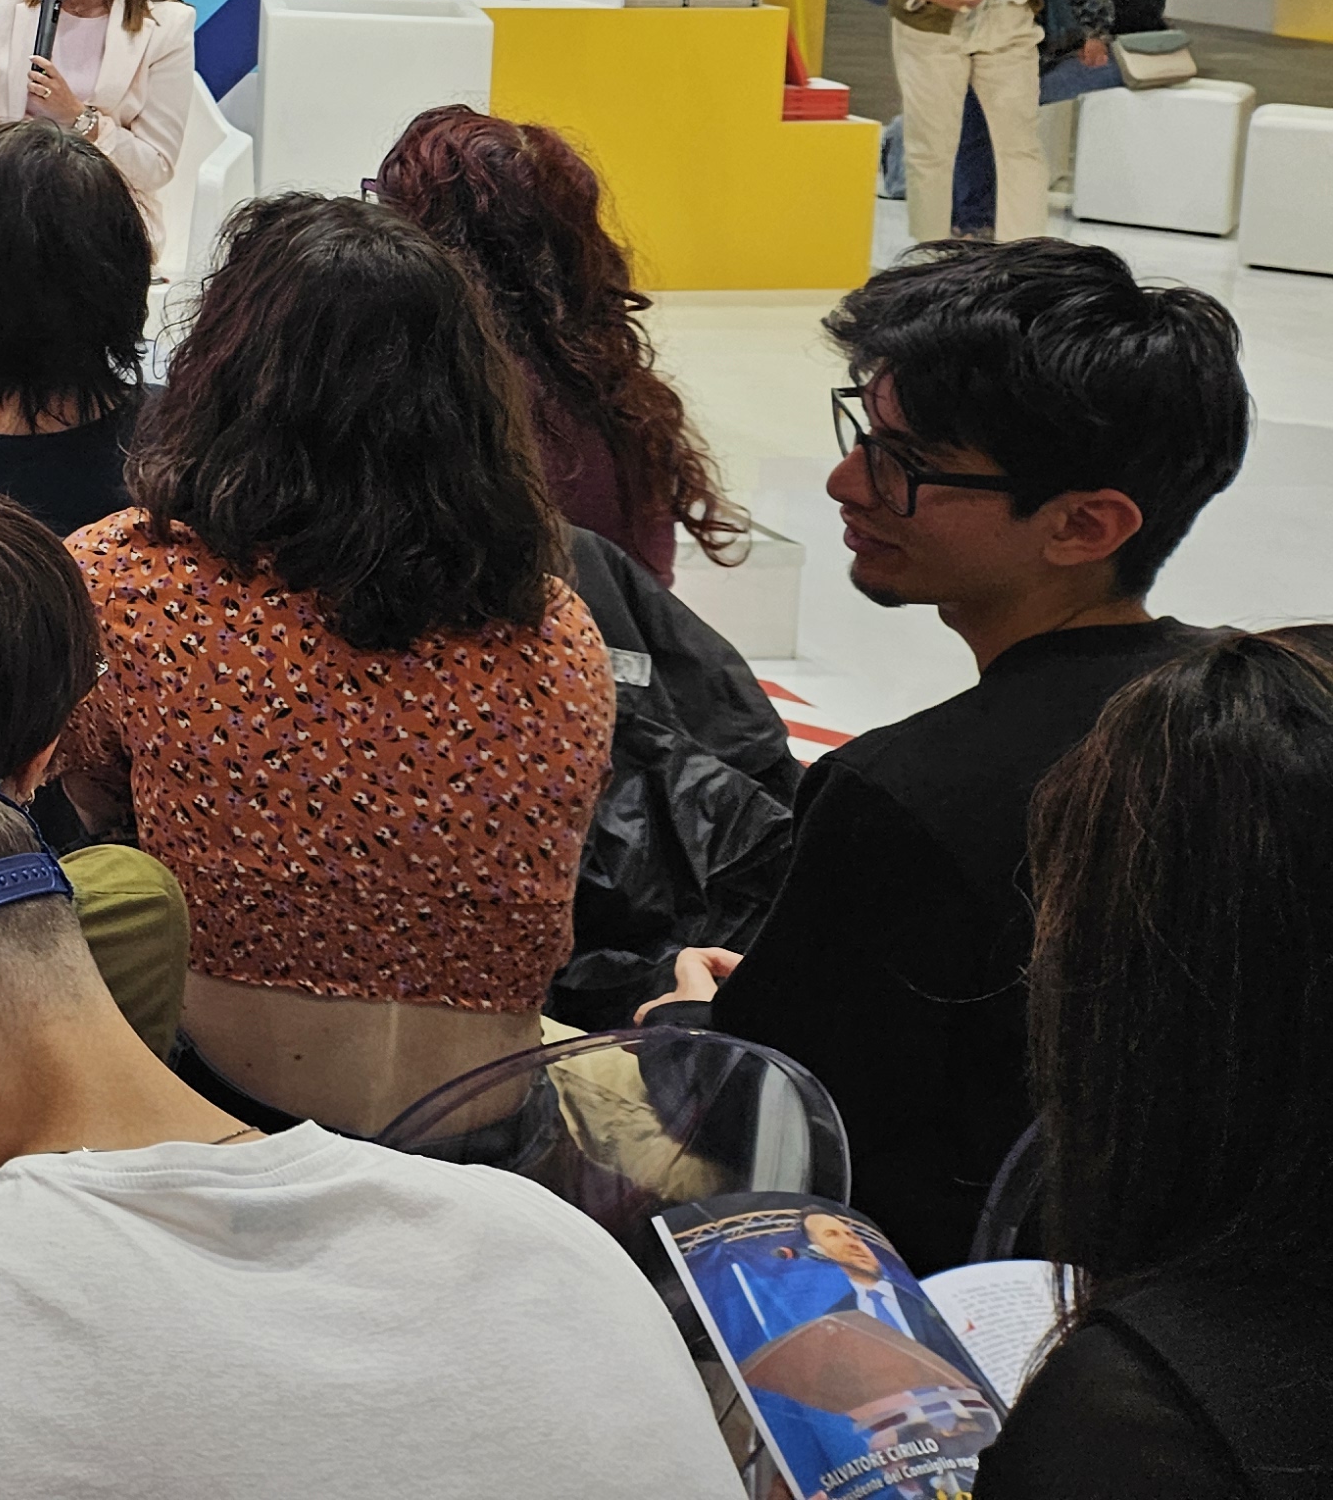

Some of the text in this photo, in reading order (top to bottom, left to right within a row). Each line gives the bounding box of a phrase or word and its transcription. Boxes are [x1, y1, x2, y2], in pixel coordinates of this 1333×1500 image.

[820, 1438, 939, 1491] SALVATORE CIRILLO
[884, 1468, 904, 1485] del
[903, 1456, 957, 1478] Consiglio
